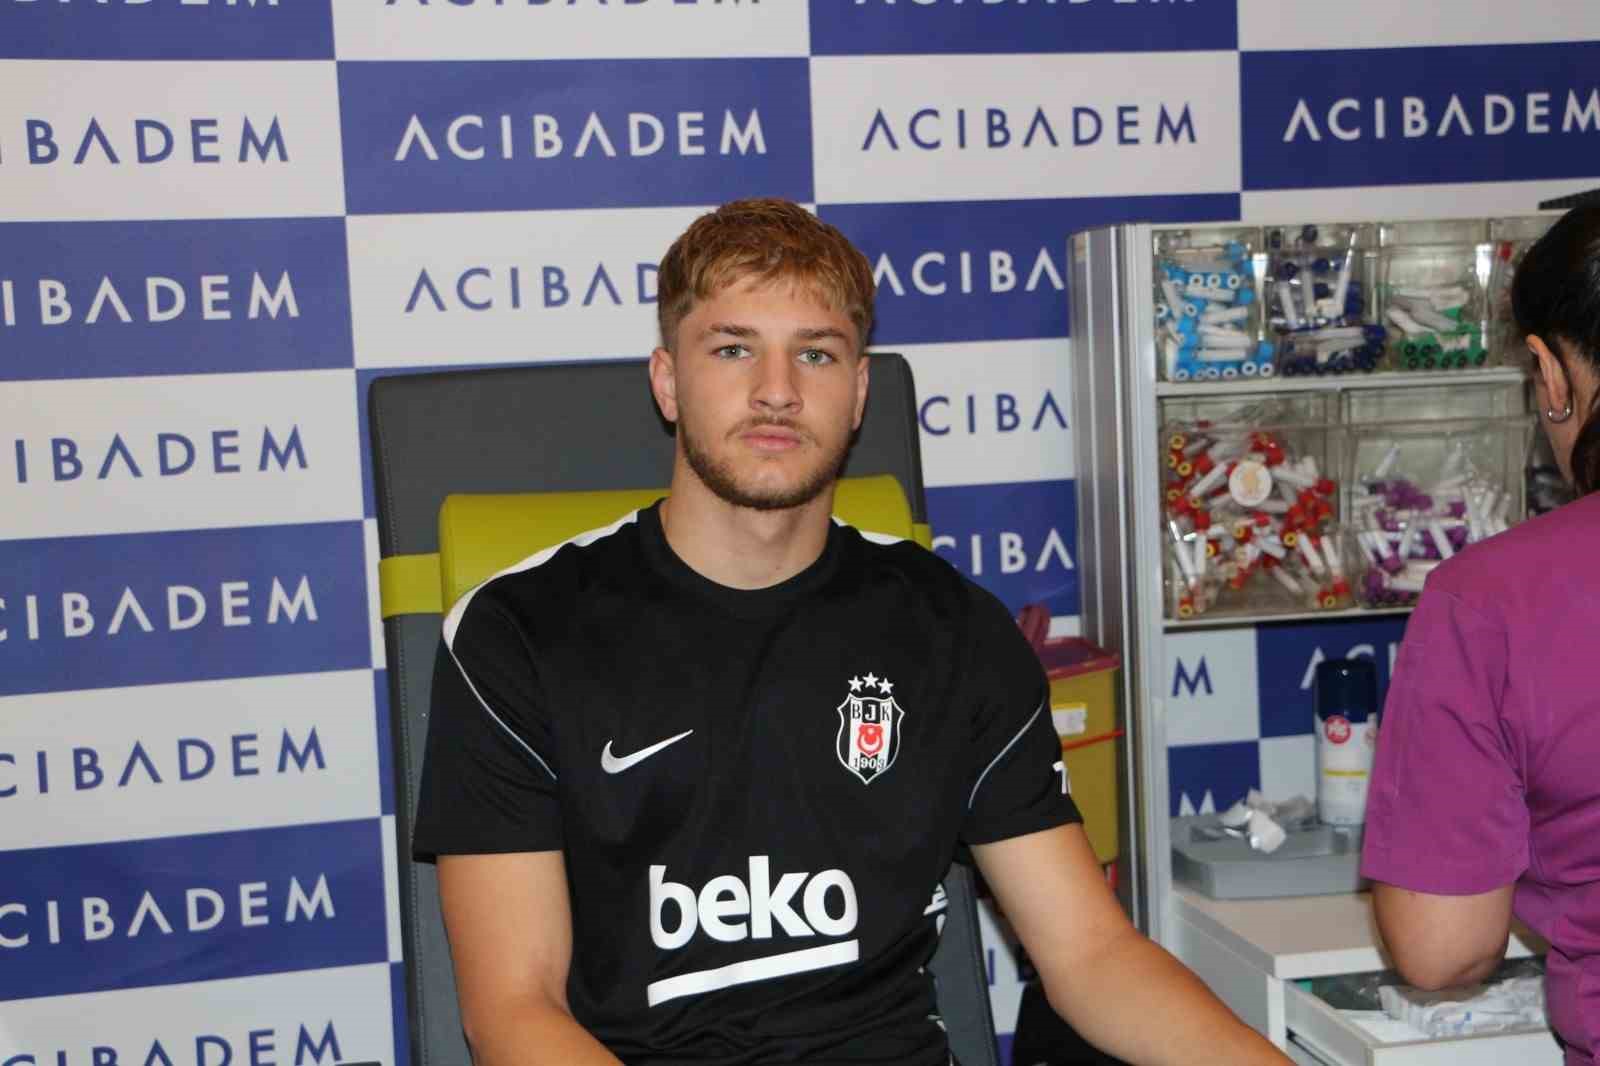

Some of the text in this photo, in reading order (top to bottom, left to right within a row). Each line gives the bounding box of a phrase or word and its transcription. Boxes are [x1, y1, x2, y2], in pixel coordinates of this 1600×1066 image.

[0, 115, 289, 165] BADEM
[394, 109, 767, 161] ACIBADEM
[862, 103, 1197, 151] ACIBADEM
[1284, 89, 1600, 142] ACIBADEM
[873, 247, 1065, 296] ACIBA
[2, 271, 300, 326] IBADEM
[919, 389, 1068, 436] CIBA
[15, 425, 308, 484] IBADEM
[0, 575, 318, 642] IBADEM
[0, 873, 335, 948] CIBADEM
[649, 855, 859, 950] beko
